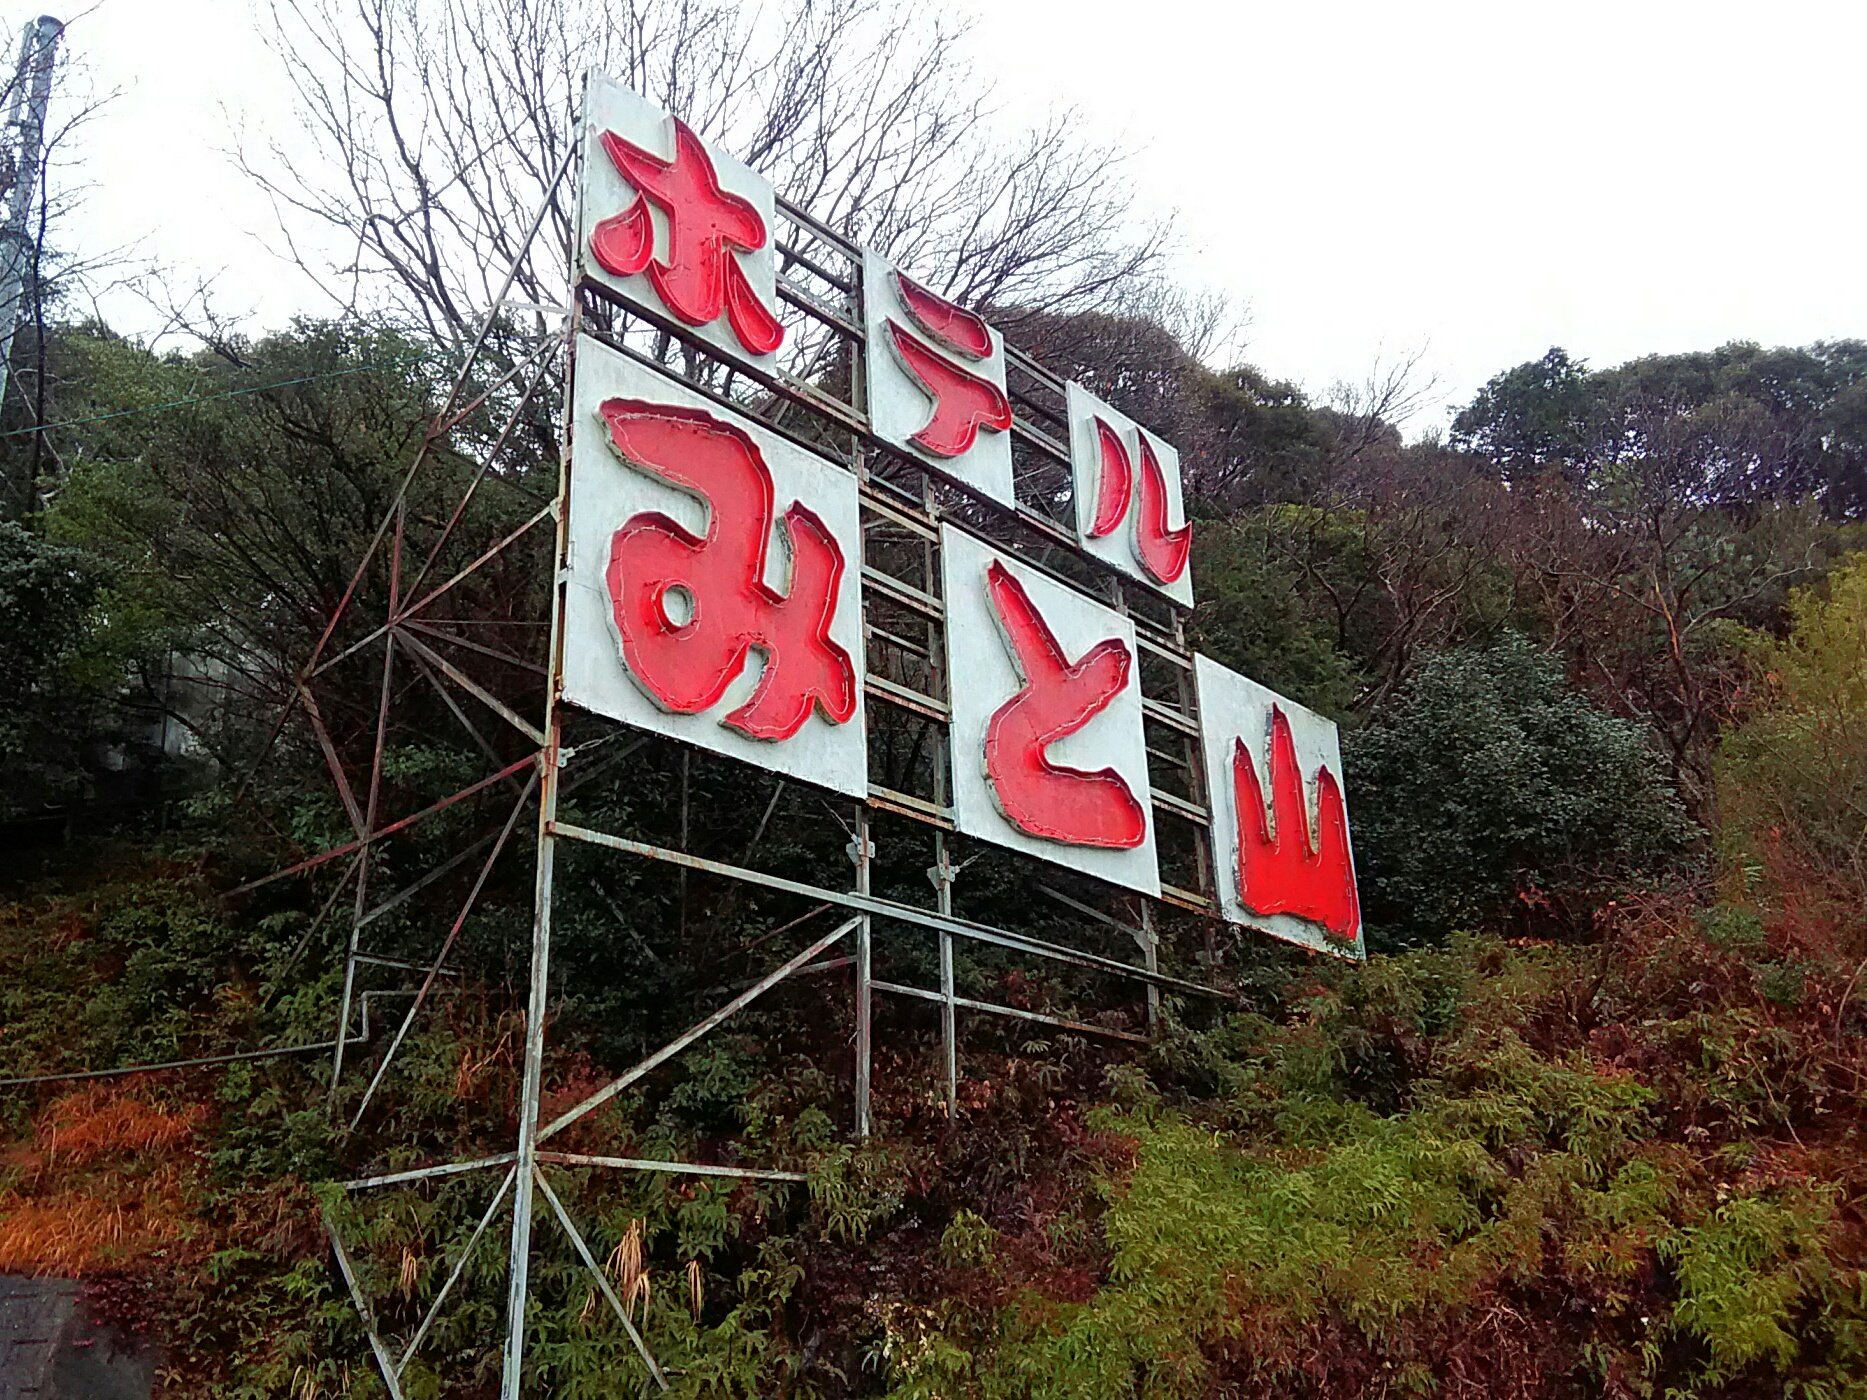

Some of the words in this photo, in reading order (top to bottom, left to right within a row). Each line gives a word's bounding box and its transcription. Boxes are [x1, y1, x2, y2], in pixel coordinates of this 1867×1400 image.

[590, 115, 1193, 585] ホテル
[599, 398, 1363, 942] みと山
